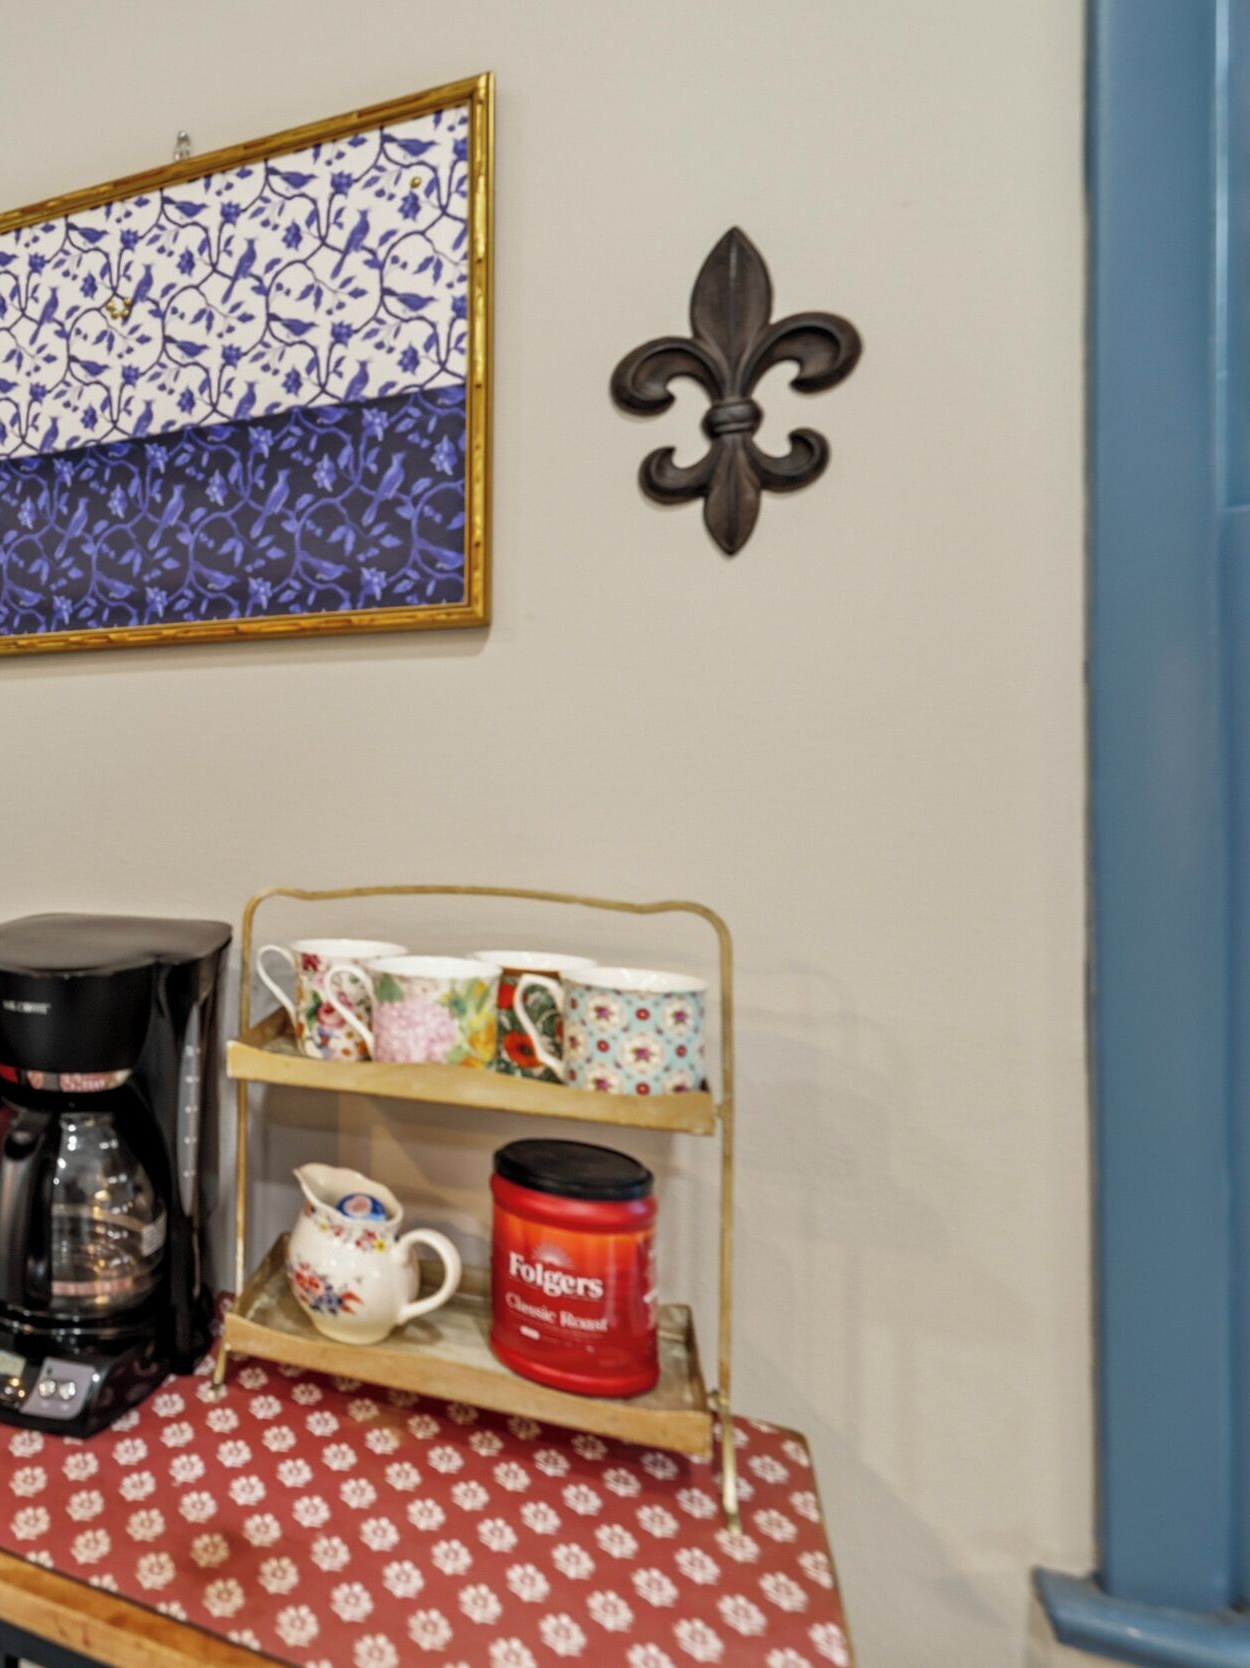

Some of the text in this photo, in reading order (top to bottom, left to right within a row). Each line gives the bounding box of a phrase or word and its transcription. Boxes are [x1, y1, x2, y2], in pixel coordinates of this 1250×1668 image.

[510, 1252, 603, 1299] Folgers
[505, 1292, 608, 1332] Classic Roast
